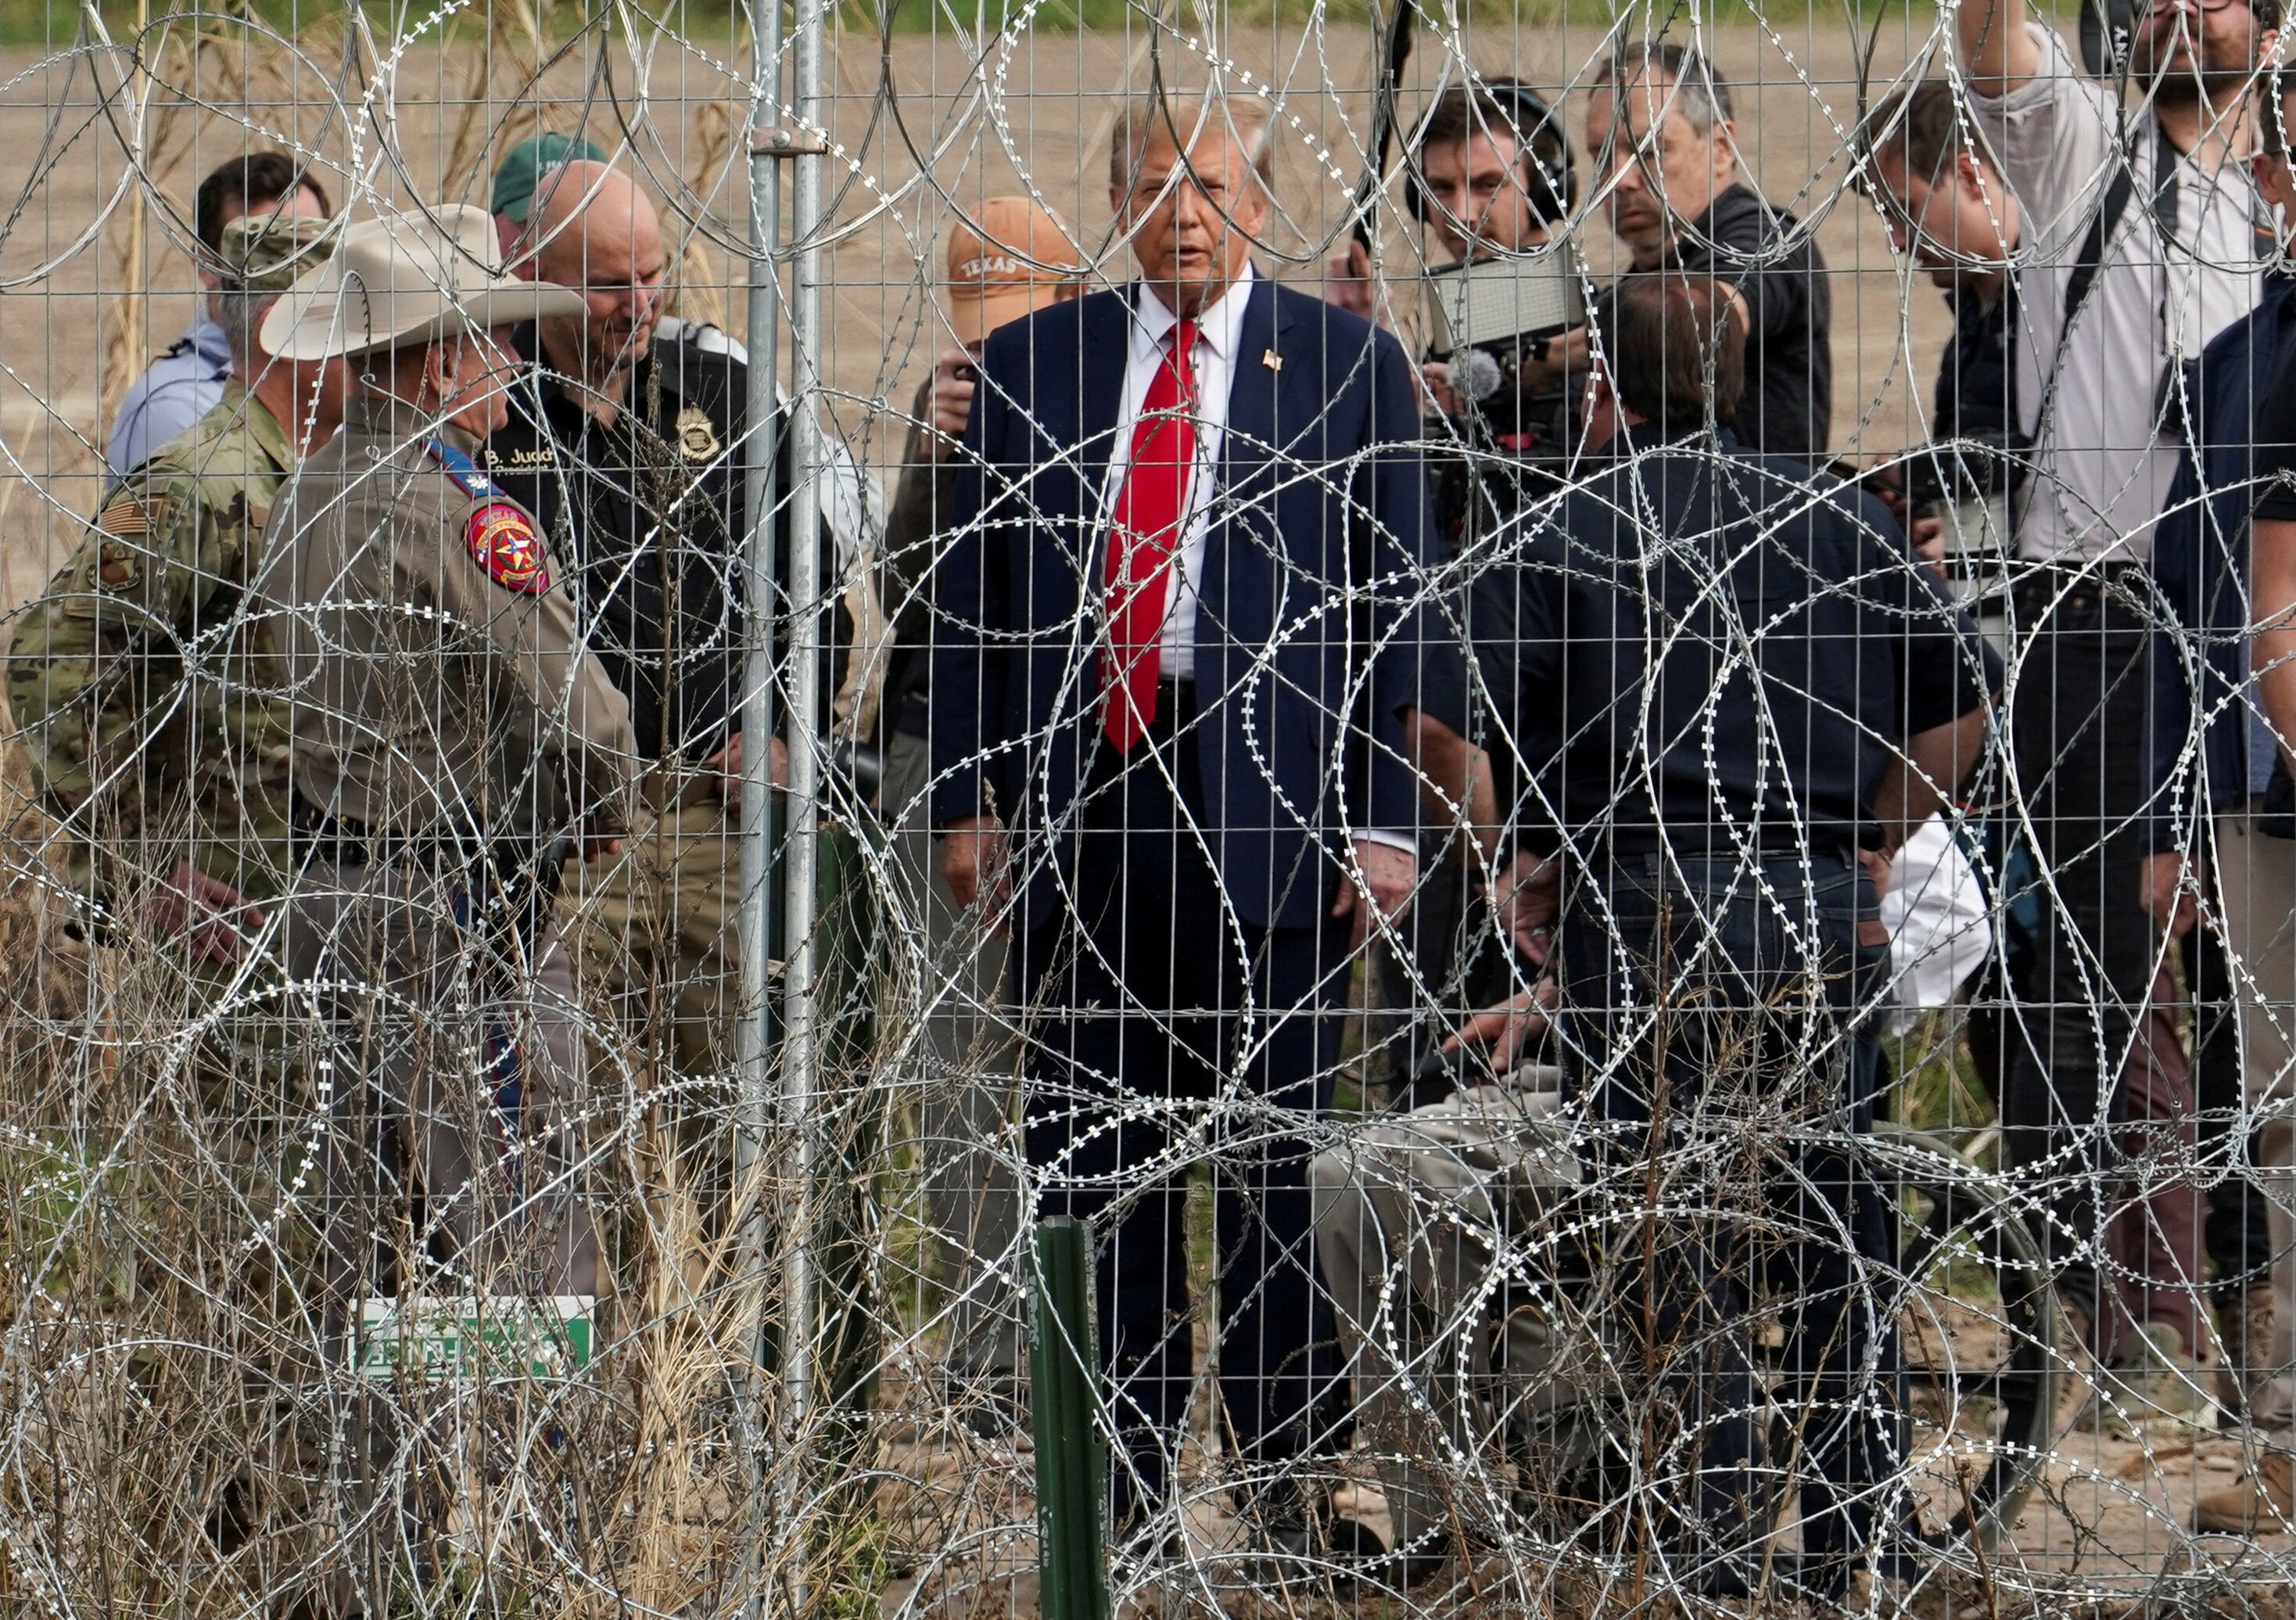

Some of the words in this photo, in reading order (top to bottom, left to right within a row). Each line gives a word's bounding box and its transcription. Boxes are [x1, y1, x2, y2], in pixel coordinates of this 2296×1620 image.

[2114, 25, 2129, 75] ONY
[960, 256, 1017, 278] TEXAS
[483, 450, 503, 465] B.
[511, 447, 553, 463] Judd
